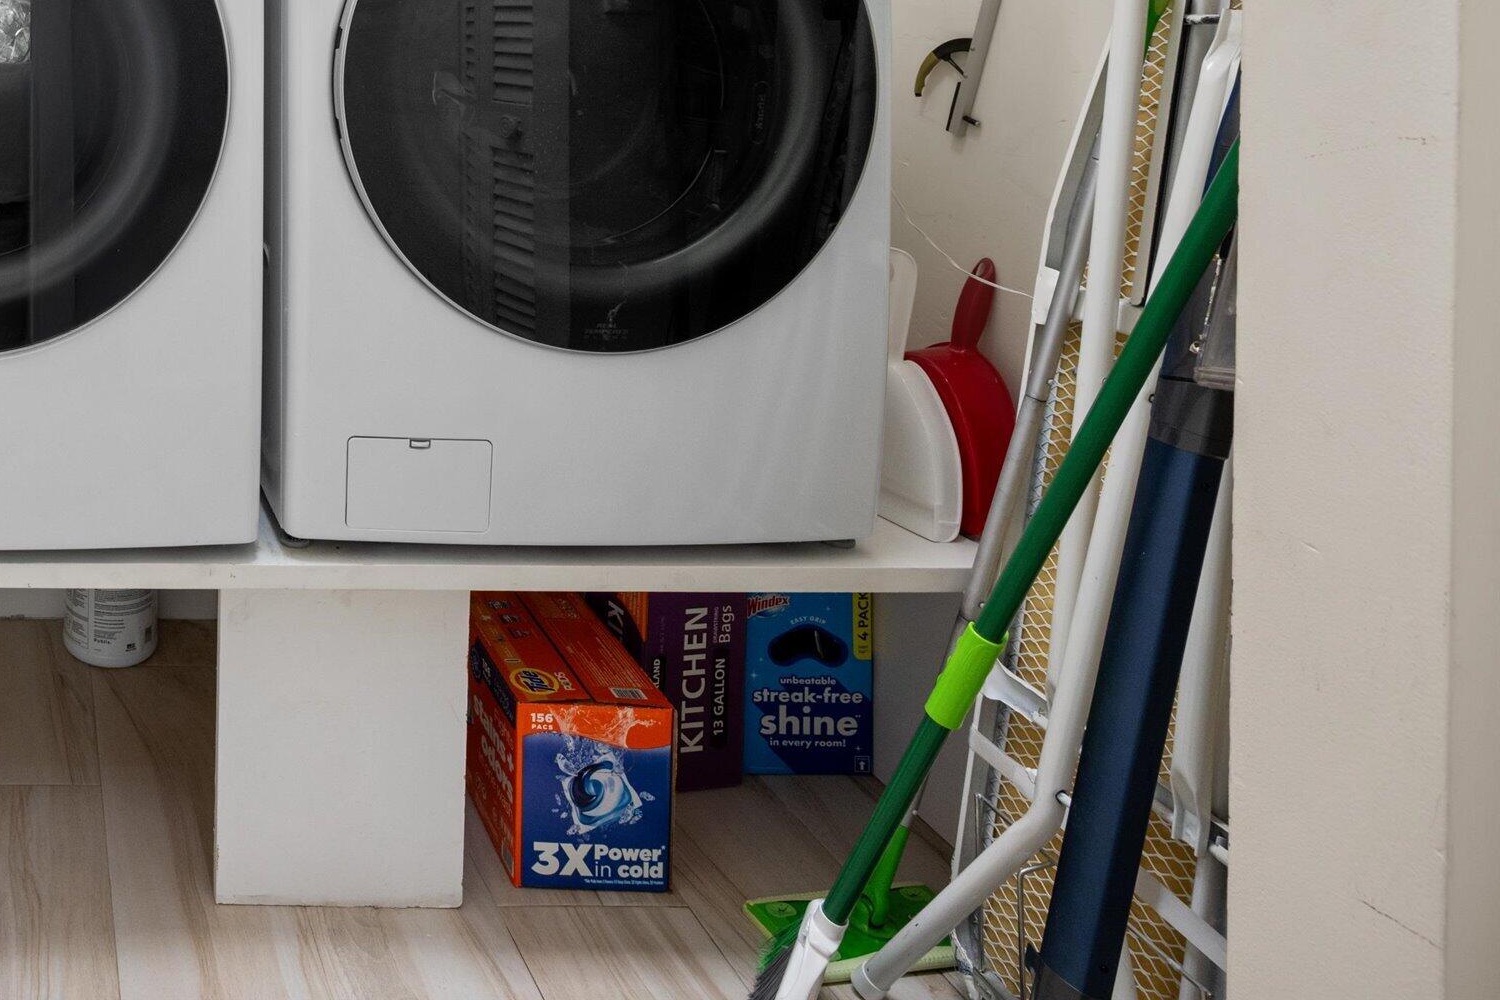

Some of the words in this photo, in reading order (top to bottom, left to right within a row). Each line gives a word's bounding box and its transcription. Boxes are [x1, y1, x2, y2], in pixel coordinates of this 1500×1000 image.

[746, 594, 790, 618] Windex
[858, 592, 869, 628] PACK
[718, 604, 735, 643] Bags
[790, 616, 807, 625] EASY
[809, 615, 826, 625] GRIP
[858, 632, 869, 641] 4
[518, 669, 556, 693] Tide
[680, 607, 708, 753] KITCHEN
[713, 657, 726, 716] GALLON
[780, 676, 837, 685] unbeatable
[753, 687, 863, 703] streak-free
[530, 713, 554, 722] 156
[713, 719, 724, 736] 13
[769, 737, 779, 746] in
[782, 739, 812, 749] every
[814, 738, 846, 747] room!
[531, 841, 593, 877] 3X
[595, 861, 611, 878] in
[617, 862, 663, 879] cold
